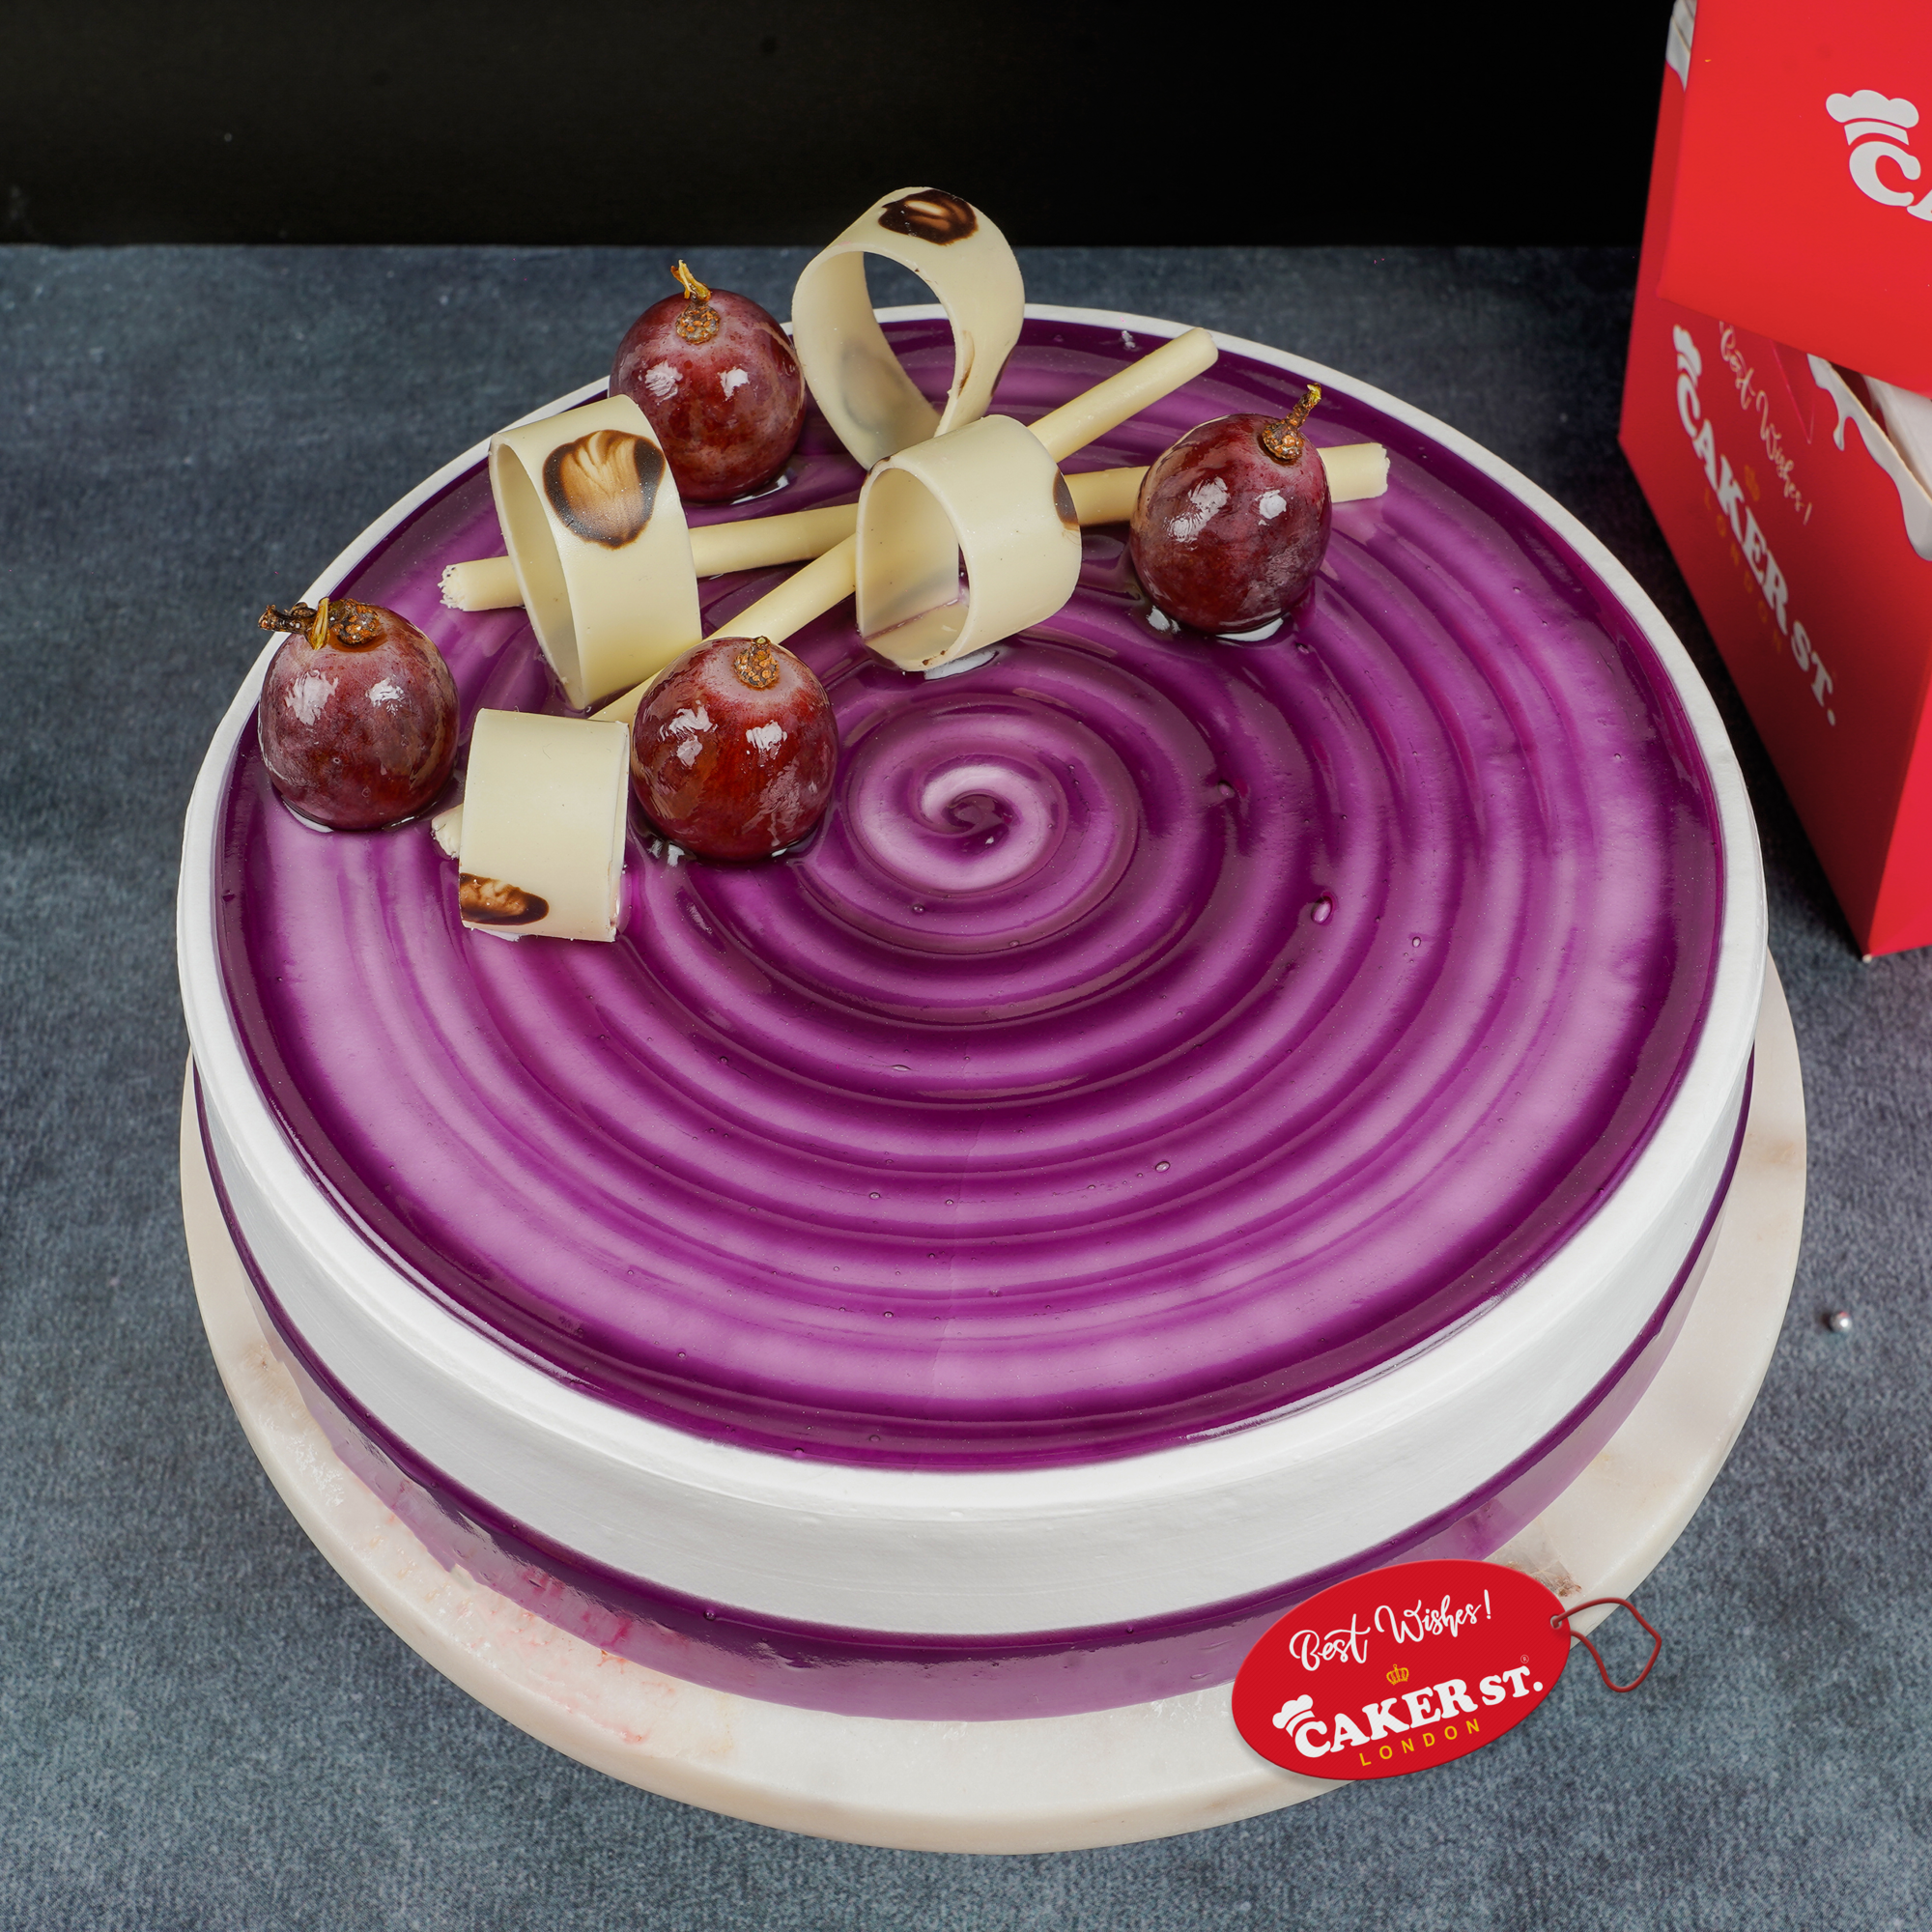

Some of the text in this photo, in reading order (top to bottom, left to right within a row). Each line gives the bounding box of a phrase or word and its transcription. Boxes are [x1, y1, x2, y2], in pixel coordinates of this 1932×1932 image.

[1677, 373, 1835, 725] CAKER ST.
[1289, 1589, 1492, 1671] Best Wishes!
[1294, 1665, 1544, 1758] CAKER ST.
[1359, 1719, 1481, 1767] LONDON
